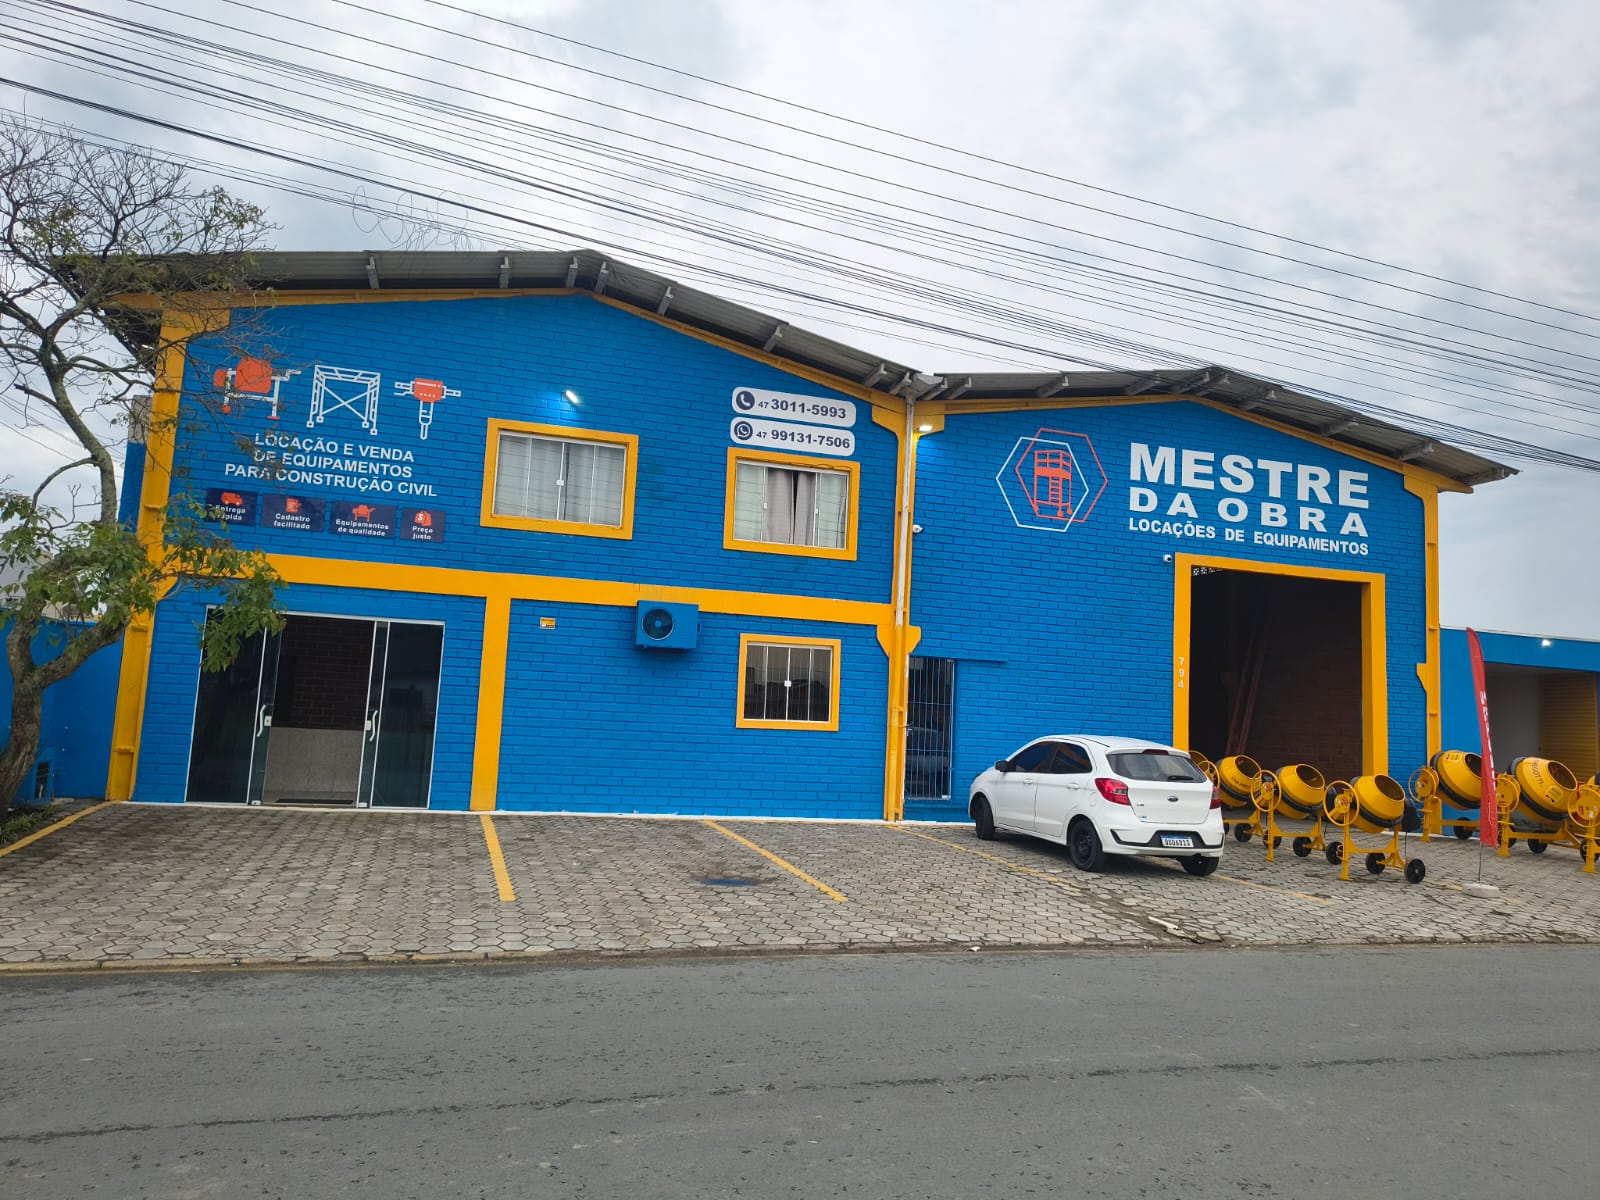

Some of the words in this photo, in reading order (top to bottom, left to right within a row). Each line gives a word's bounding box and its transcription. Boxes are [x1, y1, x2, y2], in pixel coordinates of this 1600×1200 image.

[758, 401, 769, 409] 47
[771, 399, 846, 419] 3011-5993
[254, 432, 339, 453] LOCAÇÃO
[344, 443, 354, 456] E
[358, 445, 415, 463] VENDA
[756, 431, 767, 439] 47
[771, 429, 850, 449] 99131-7506
[253, 450, 277, 462] DE
[282, 452, 413, 479] EQUIPAMENTOS
[225, 463, 270, 481] PARA
[276, 467, 393, 492] CONSTRUÇÃO
[397, 481, 438, 497] CIVIL
[1130, 442, 1369, 509] MESTRE
[273, 520, 311, 530] facilitado
[275, 513, 311, 523] Cadastro
[336, 518, 389, 530] Equipamentos
[348, 527, 386, 537] qualidade
[412, 526, 433, 534] Preço
[1129, 517, 1216, 539] LOCAÇÕES
[1224, 527, 1245, 543] DE
[1253, 531, 1369, 556] EQUIPAMENTOS
